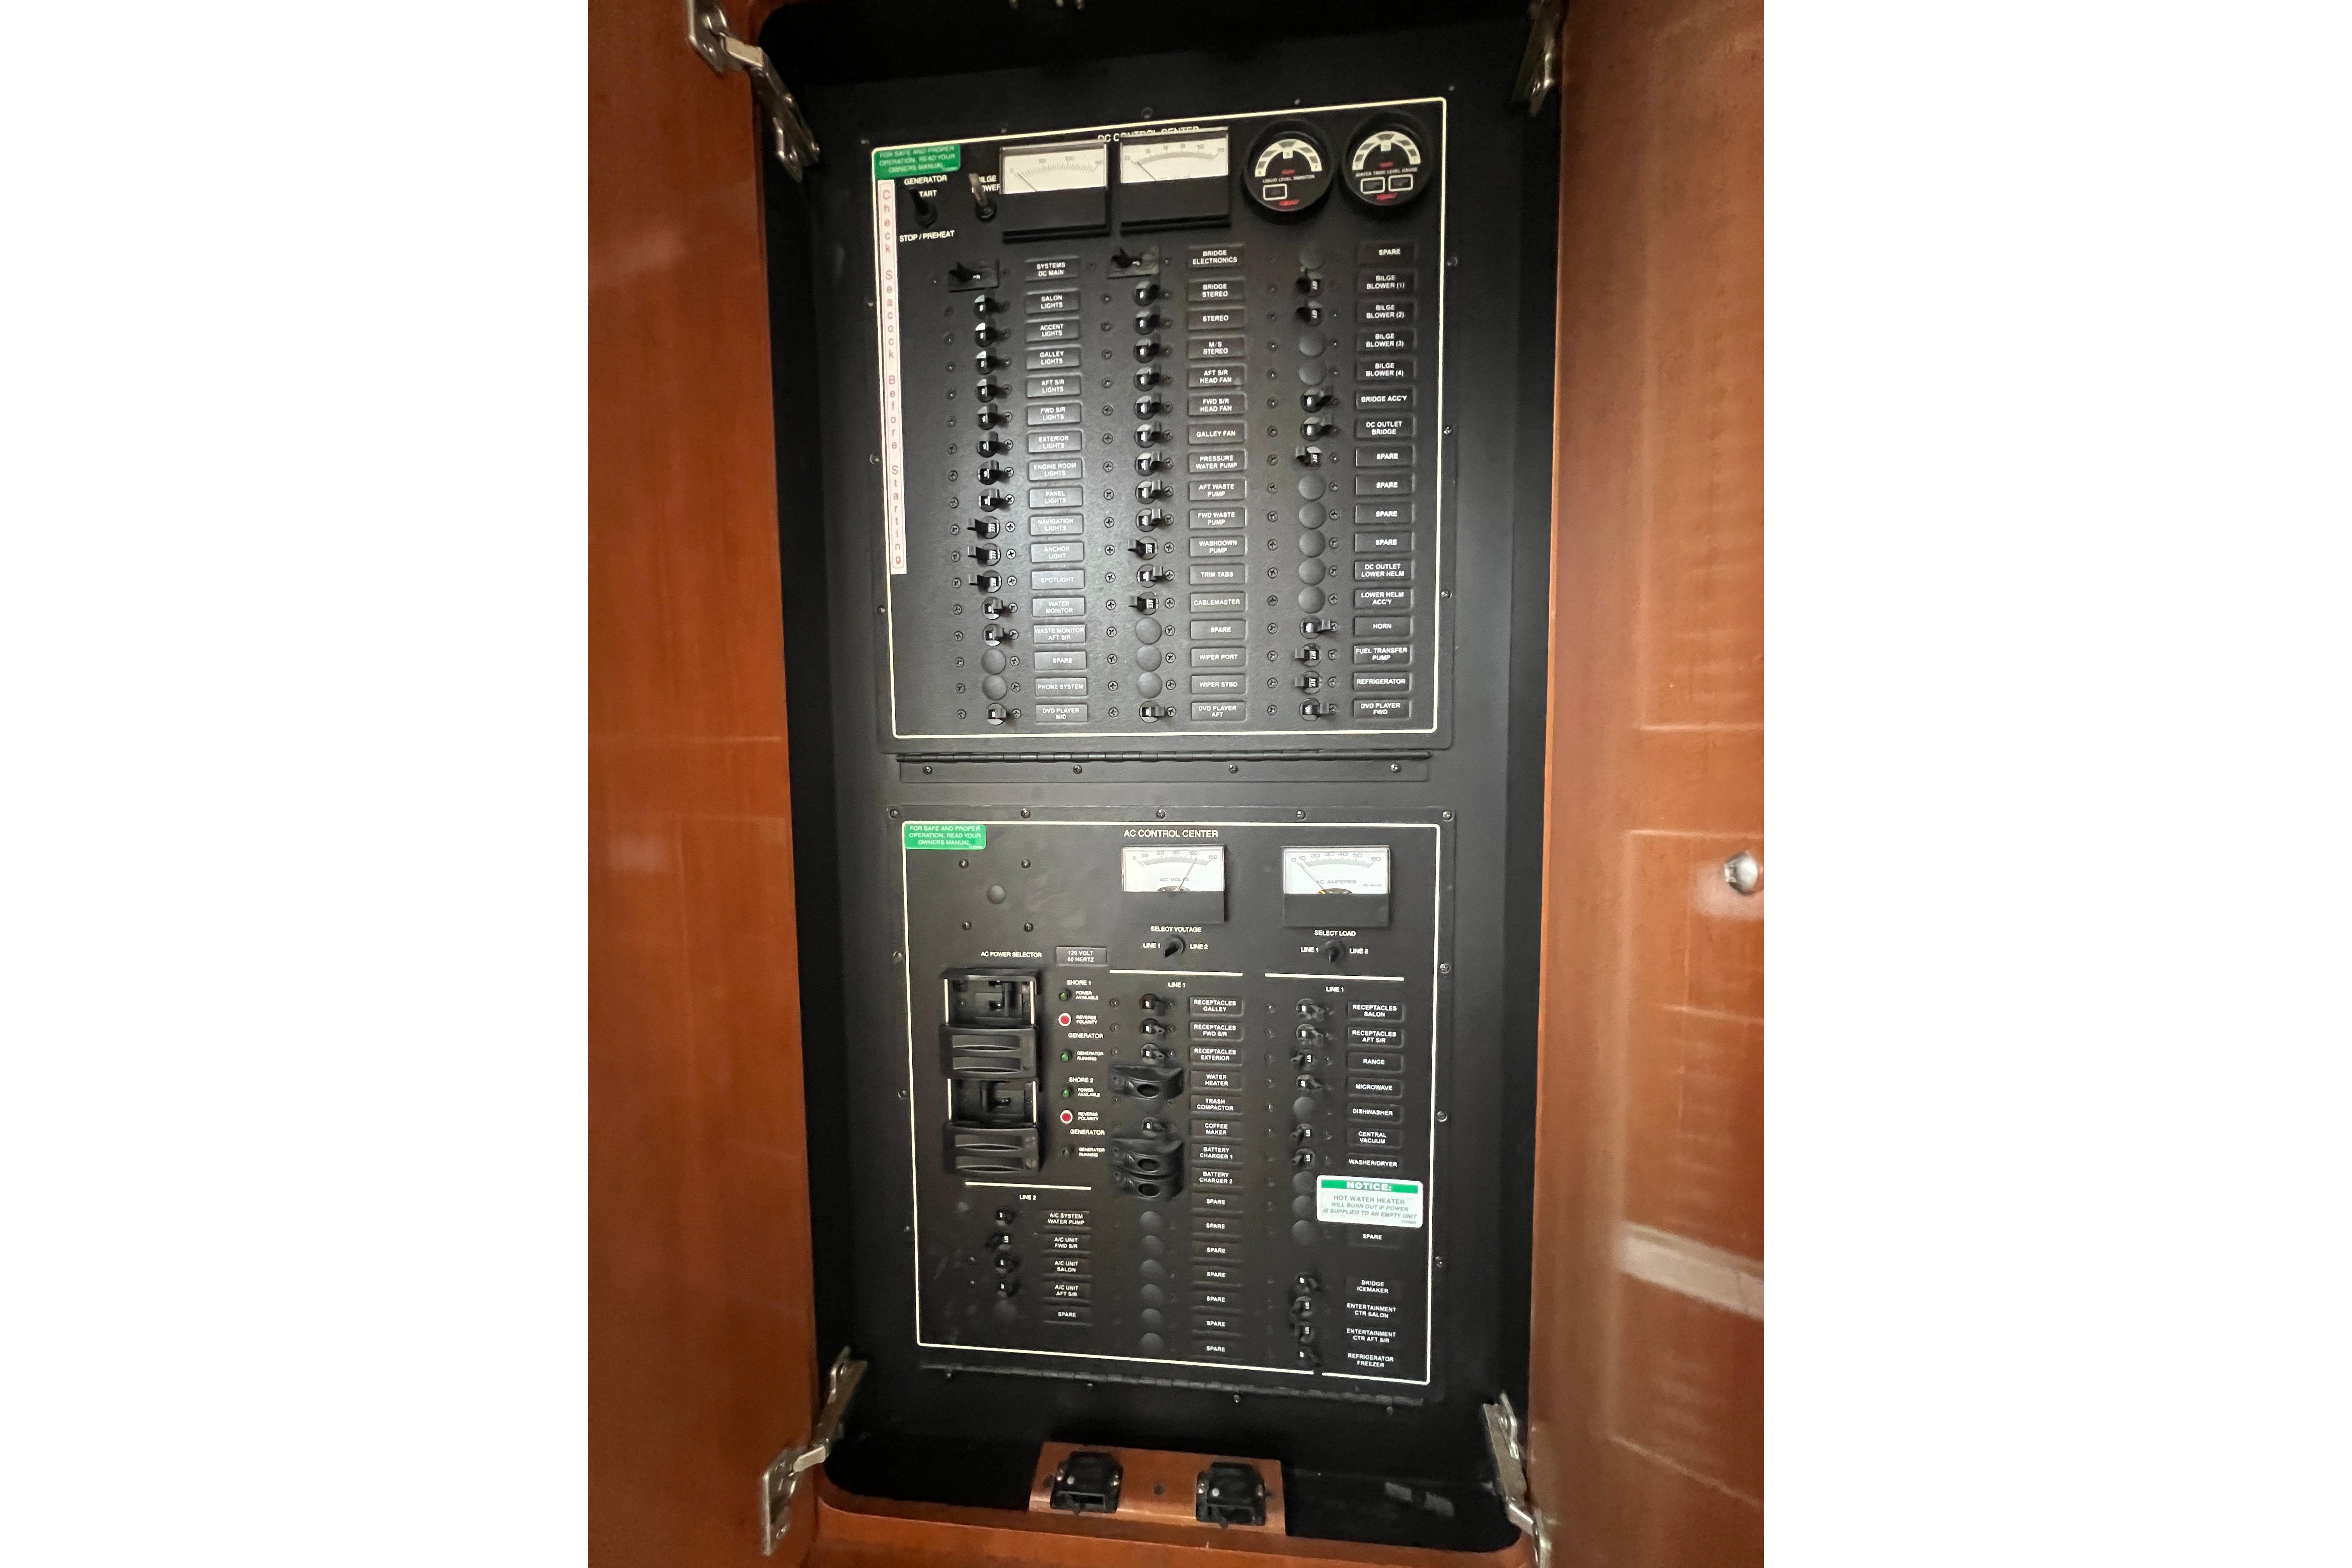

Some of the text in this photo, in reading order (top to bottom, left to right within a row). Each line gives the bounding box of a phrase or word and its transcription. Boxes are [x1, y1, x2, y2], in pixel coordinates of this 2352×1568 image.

[904, 175, 947, 185] GENERATOR
[900, 234, 917, 242] STOP
[923, 230, 955, 240] PREHEAT
[882, 189, 901, 565] Check Seacock Before Starting
[1124, 829, 1218, 838] AC CONTROL CENTER
[1347, 1181, 1392, 1191] NOTICE:
[1347, 1303, 1396, 1312] ENTERTAINMENT
